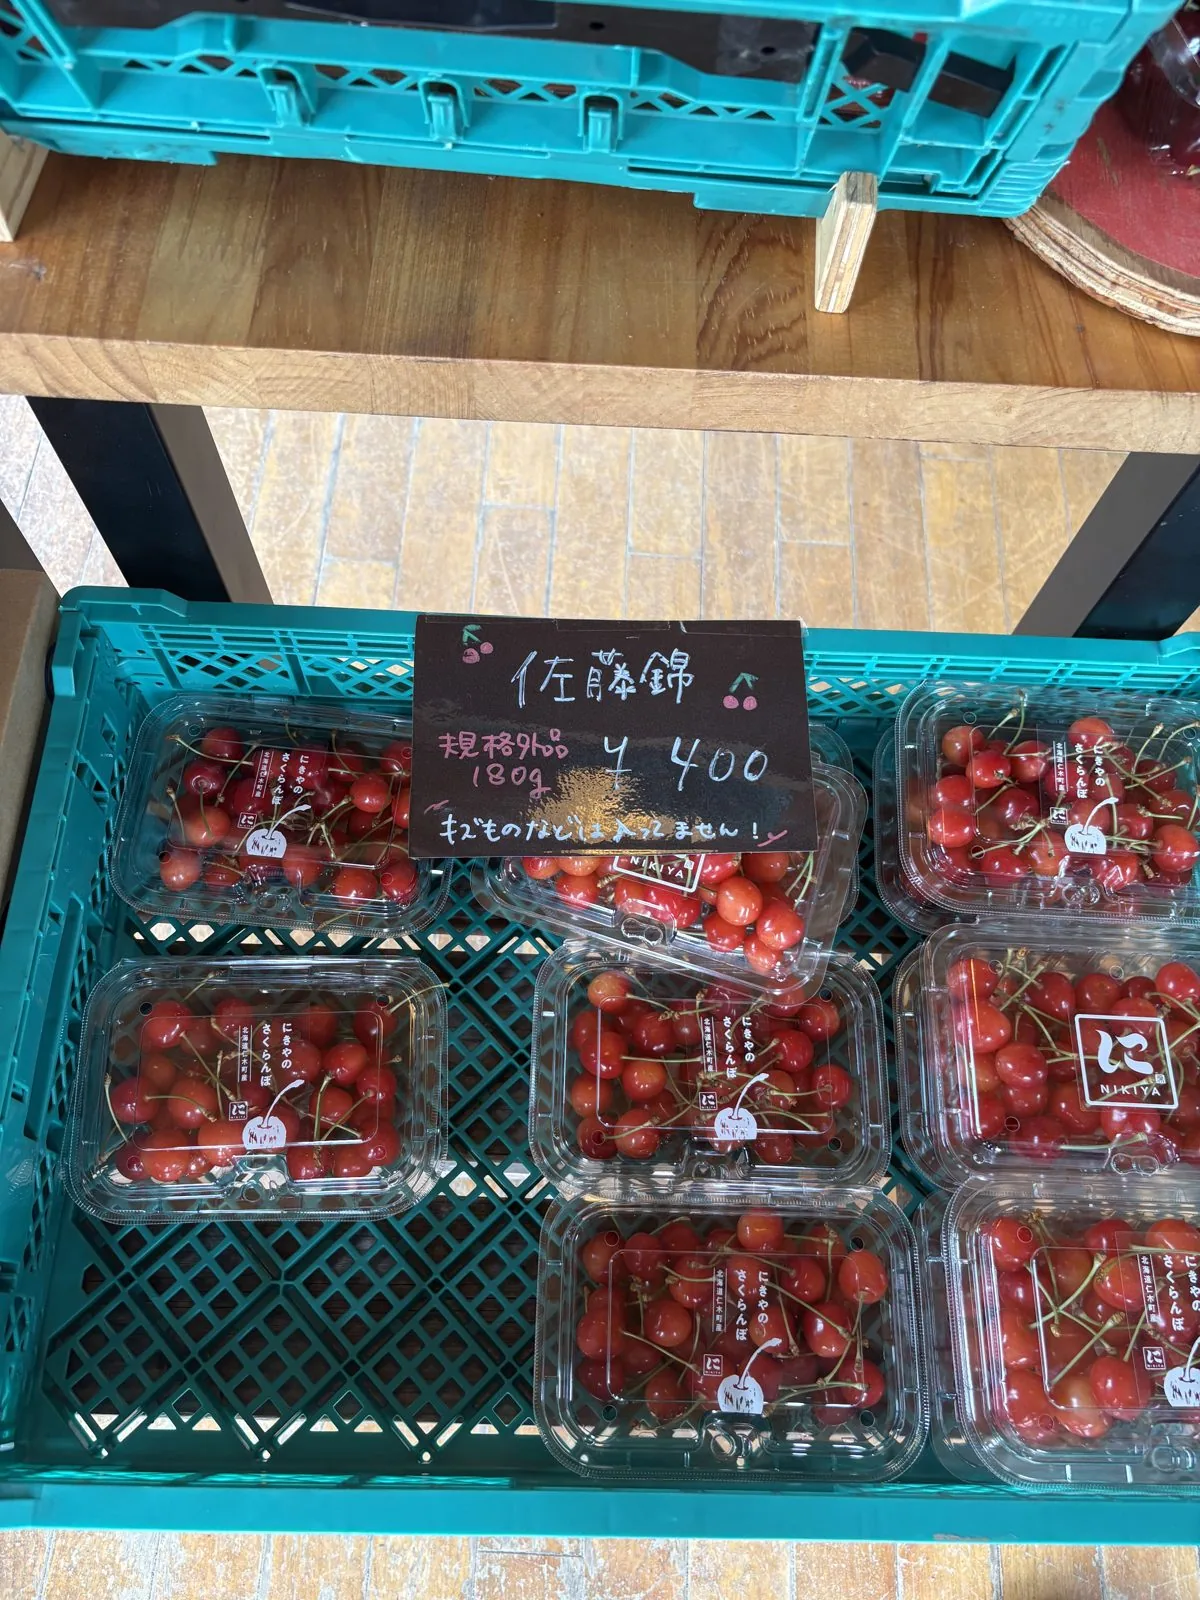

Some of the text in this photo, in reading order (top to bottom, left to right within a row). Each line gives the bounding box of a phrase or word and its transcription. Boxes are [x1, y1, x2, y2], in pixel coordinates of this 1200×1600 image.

[510, 647, 695, 709] 佐藤錦
[437, 728, 570, 760] 規格外品
[670, 735, 769, 792] 400
[271, 752, 291, 805] さくらんぼ
[293, 754, 311, 794] にきやの
[471, 762, 552, 800] 180g
[629, 856, 684, 879] NIKIYA
[260, 1023, 273, 1087] さくらんぼ
[281, 1022, 293, 1069] にきやの
[722, 1016, 738, 1079] さくらんぼ
[741, 1016, 756, 1062] にきやの
[1095, 1029, 1154, 1075] に
[231, 1104, 247, 1115] に
[701, 1094, 716, 1106] に
[1100, 1084, 1161, 1097] NIKIYA
[735, 1268, 749, 1341] さくらんぼ
[757, 1270, 770, 1324] にきやの
[1162, 1254, 1185, 1332] さくらんぼ
[706, 1357, 721, 1370] に
[1146, 1349, 1163, 1363] に
